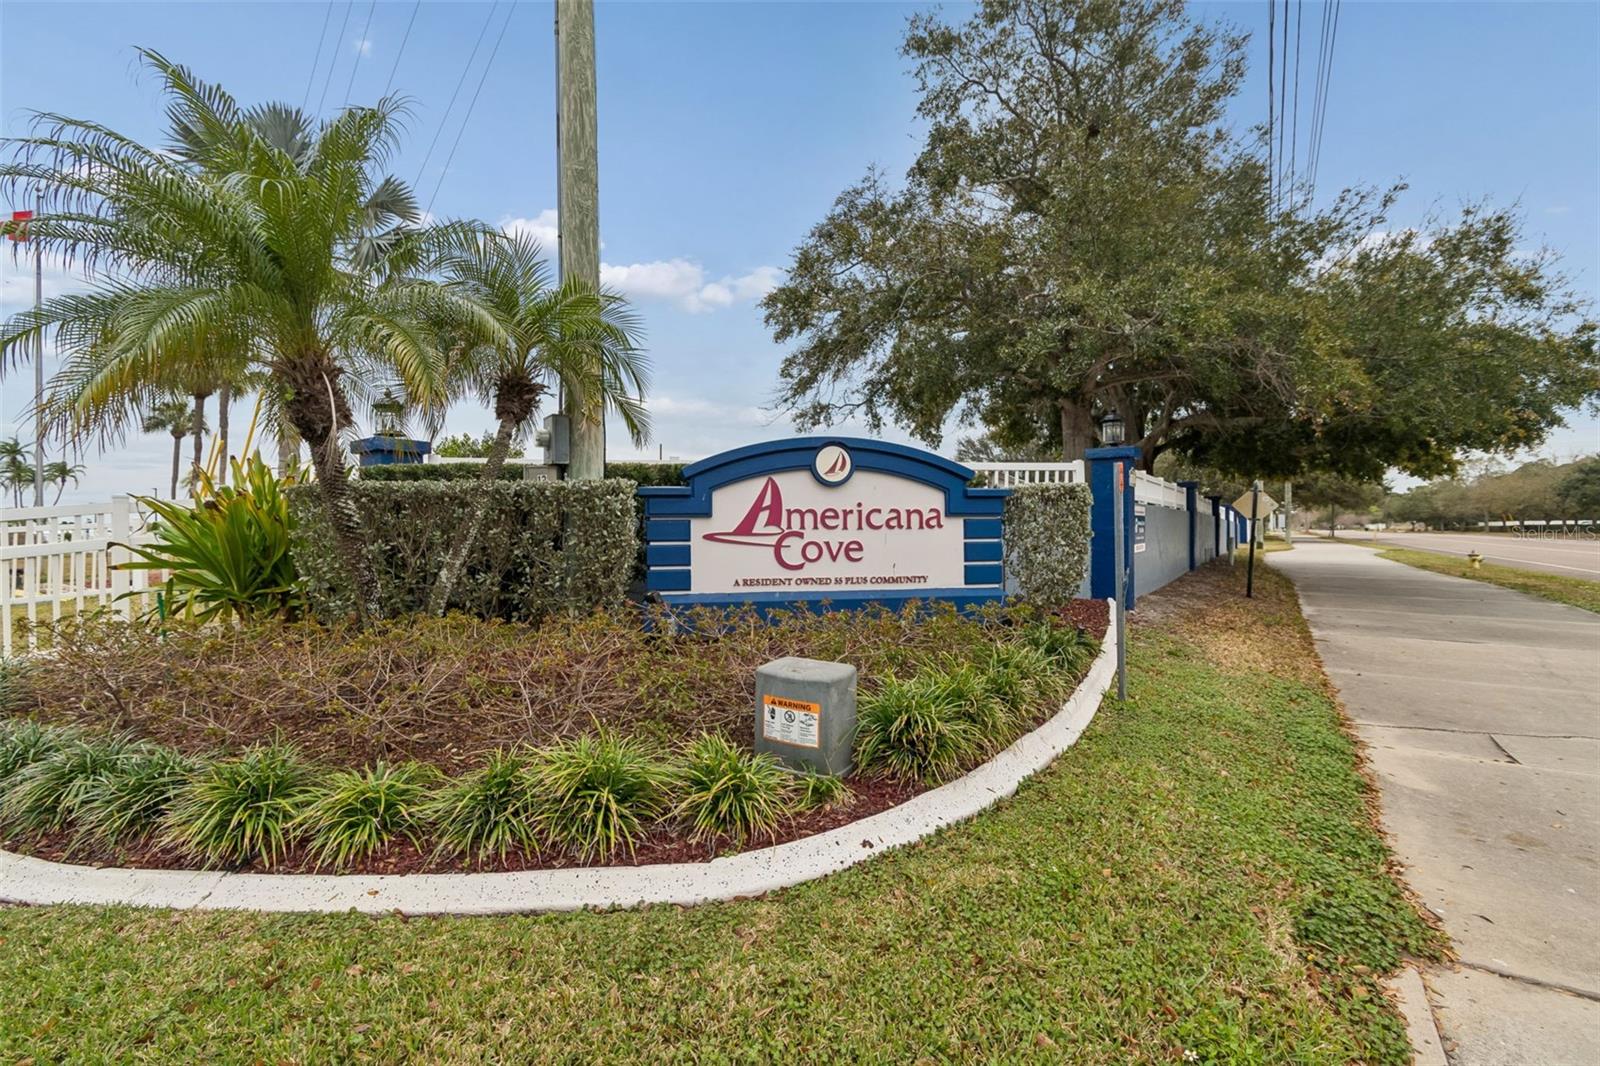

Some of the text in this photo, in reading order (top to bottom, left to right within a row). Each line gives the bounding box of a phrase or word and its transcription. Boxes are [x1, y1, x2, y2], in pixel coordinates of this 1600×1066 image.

[731, 476, 944, 533] Americana
[774, 530, 864, 571] Cove
[733, 578, 741, 587] A
[742, 577, 793, 587] RESIDENT
[794, 576, 832, 586] OWNED
[844, 576, 868, 585] PLUS
[869, 575, 929, 585] COMMUNITY
[777, 700, 812, 711] WARNING
